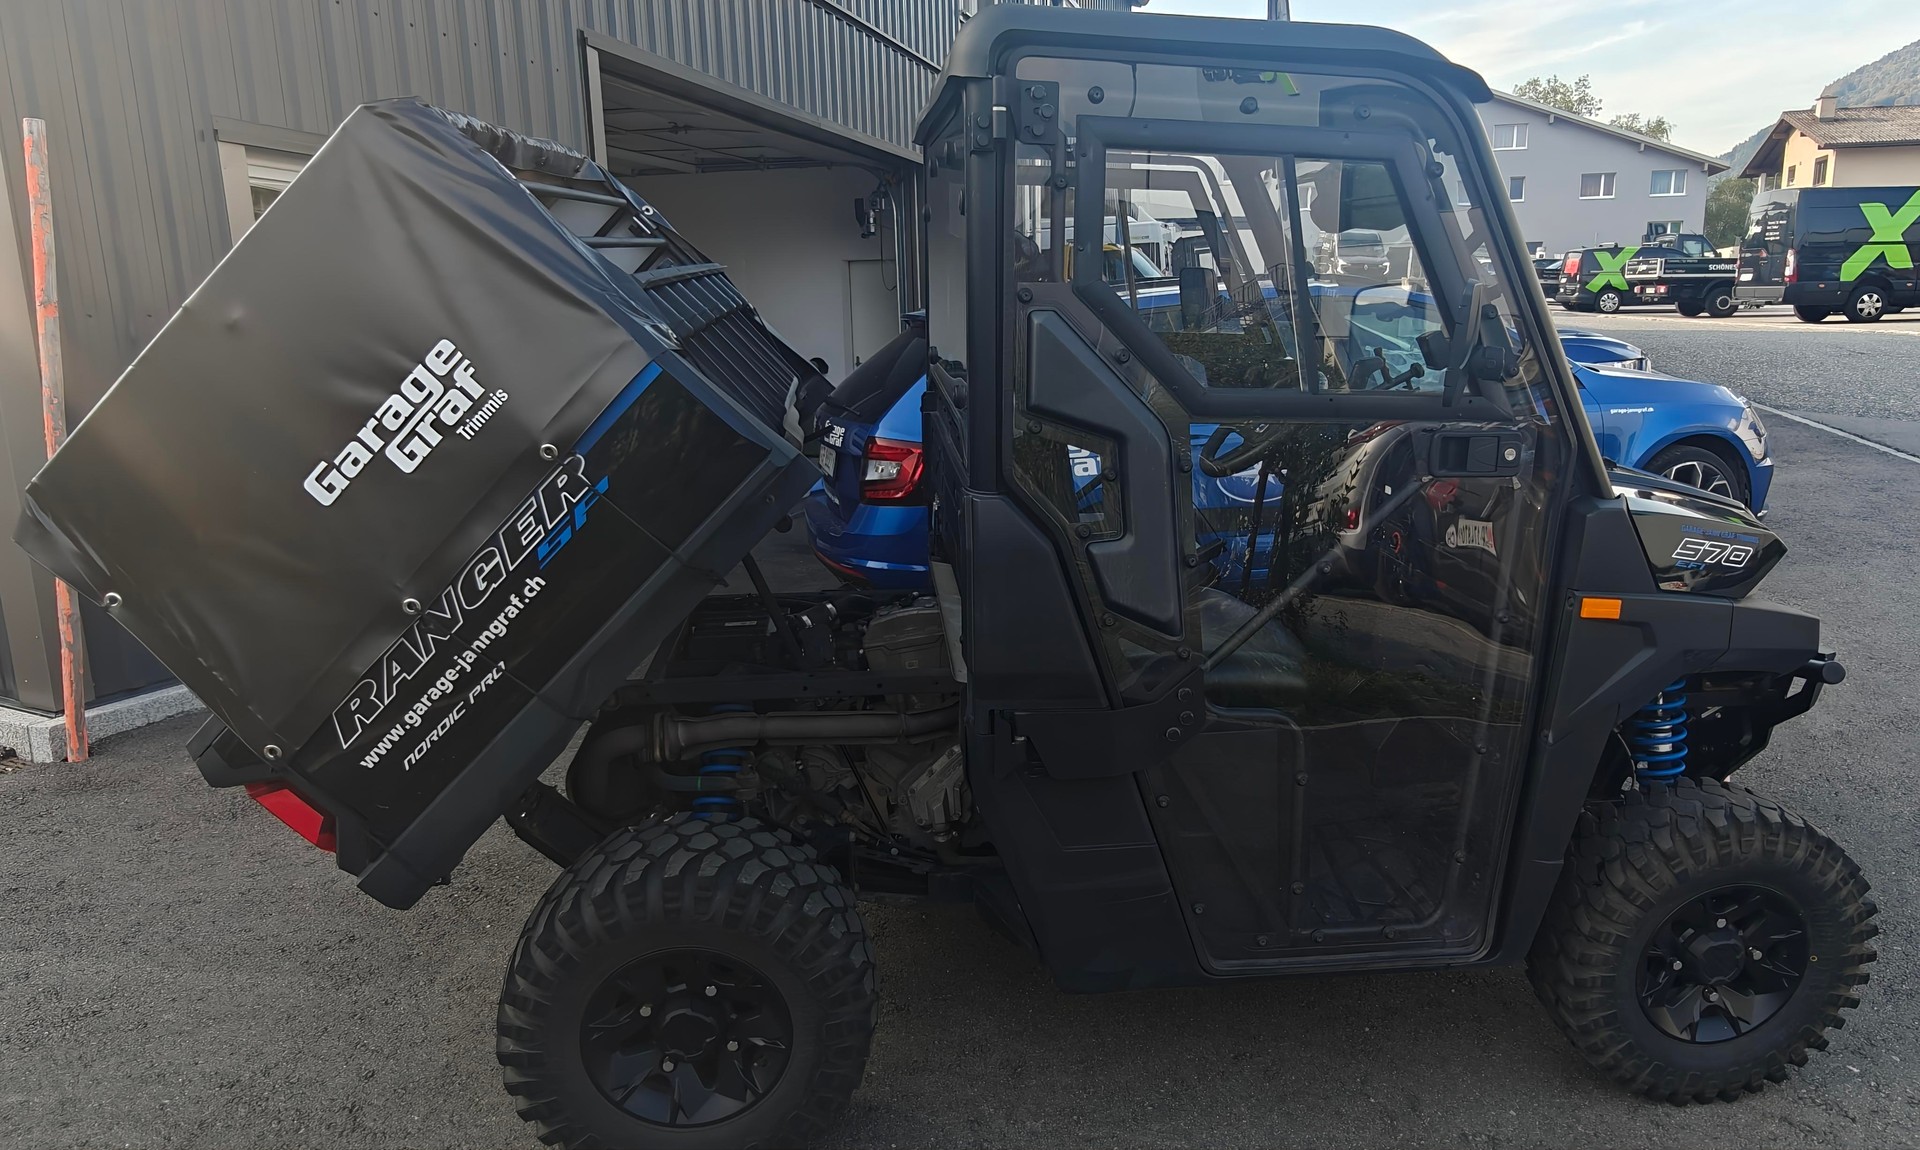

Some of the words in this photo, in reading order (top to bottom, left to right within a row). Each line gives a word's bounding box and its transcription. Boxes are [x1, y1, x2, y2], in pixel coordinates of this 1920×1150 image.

[303, 338, 461, 507] Garage
[384, 360, 487, 475] Graf
[456, 388, 509, 441] Trimmis
[537, 474, 609, 570] SP
[1671, 538, 1754, 568] 570
[1675, 559, 1706, 571] EFI
[333, 453, 592, 749] RANGER
[360, 574, 547, 770] www.garage-janngraf.ch
[404, 701, 466, 772] NORDIC
[468, 660, 506, 705] PRO
